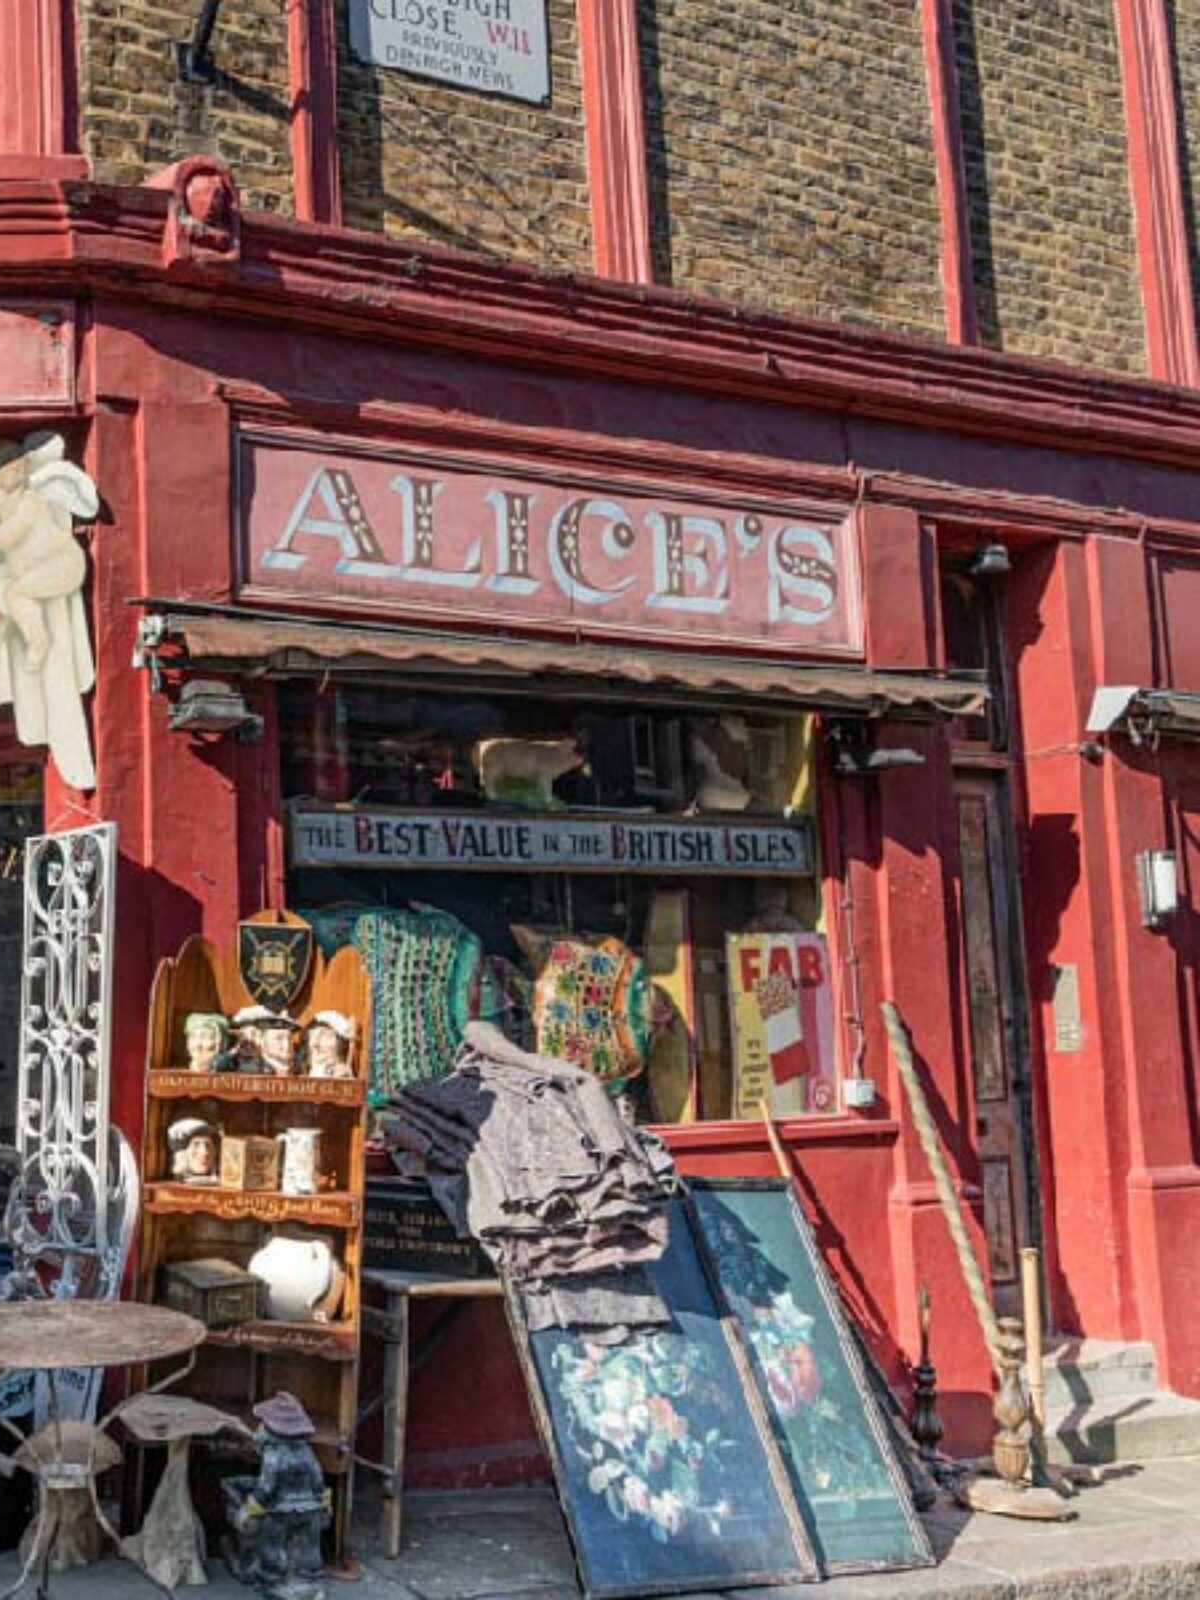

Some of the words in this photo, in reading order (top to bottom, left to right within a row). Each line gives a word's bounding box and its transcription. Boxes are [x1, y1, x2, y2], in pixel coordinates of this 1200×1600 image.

[260, 466, 838, 625] ALICE'S
[301, 825, 347, 849] THE
[354, 816, 431, 856] BEST
[441, 818, 532, 860] VALUE
[542, 833, 560, 854] IN
[568, 834, 601, 855] THE
[610, 822, 713, 862] BRITISH
[723, 827, 797, 863] ISLES
[739, 945, 825, 993] FAB
